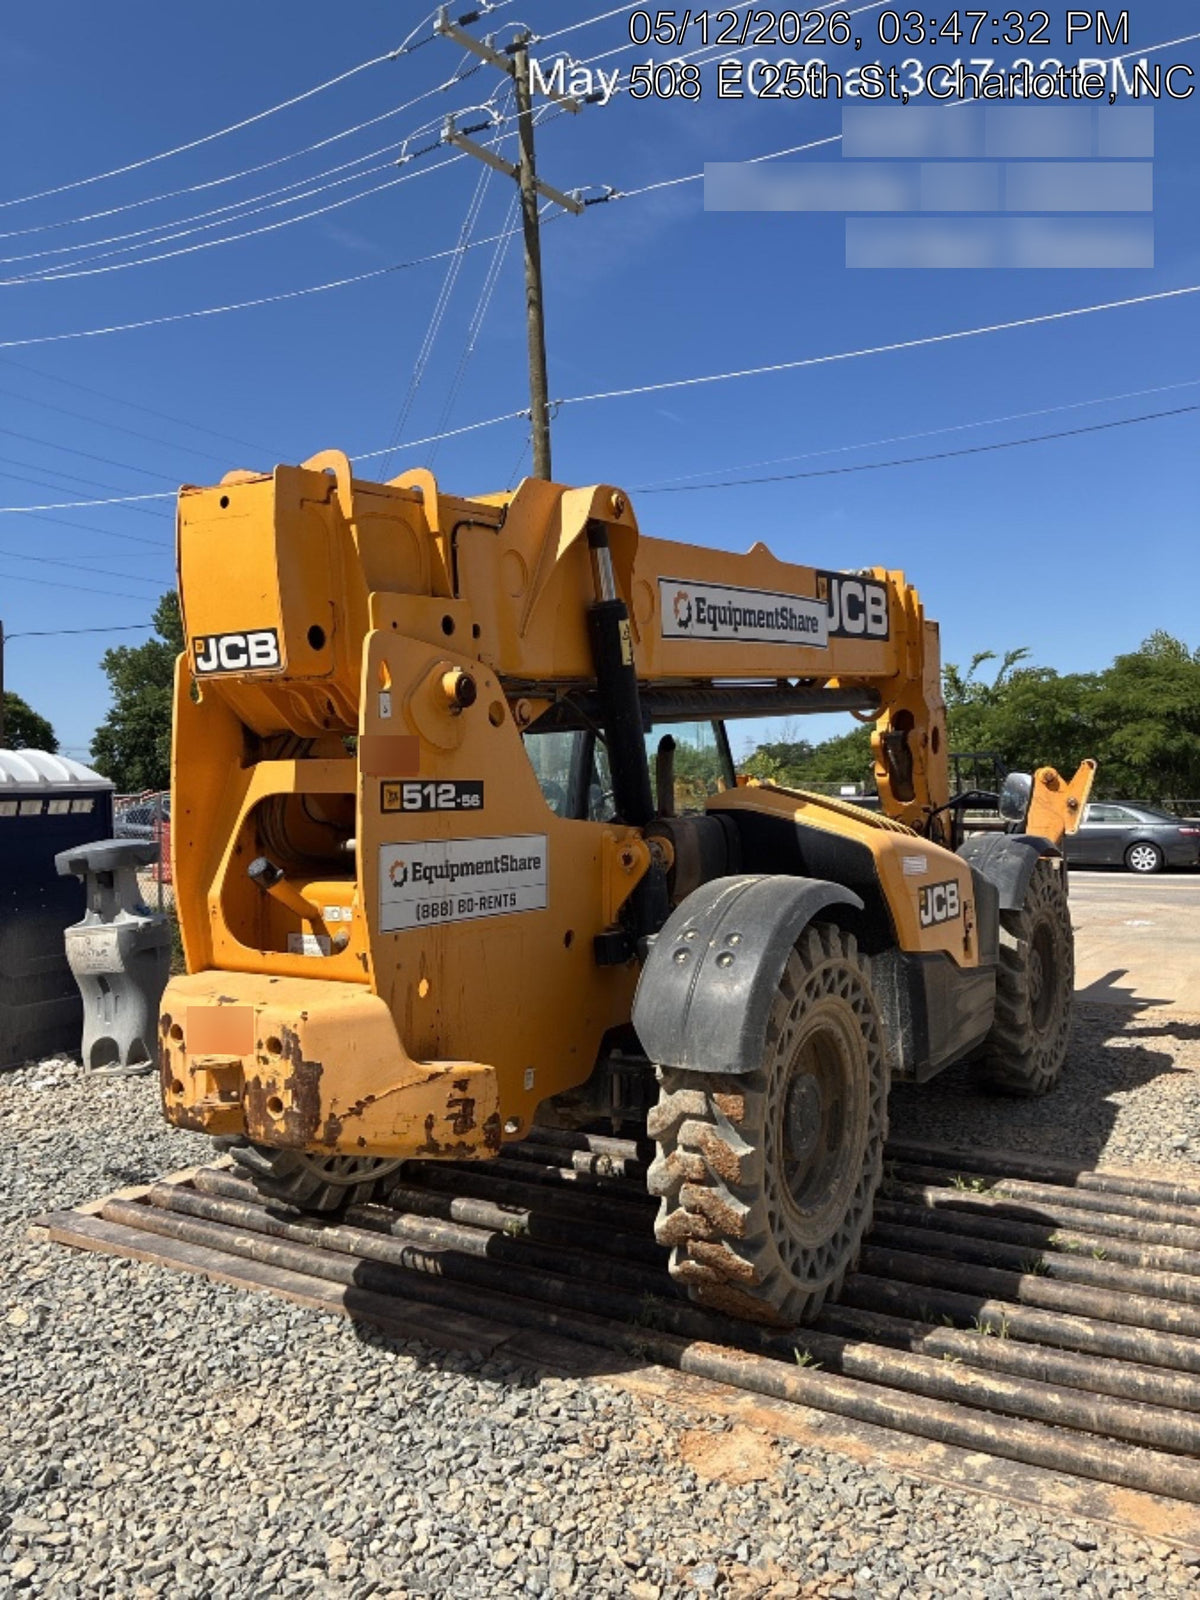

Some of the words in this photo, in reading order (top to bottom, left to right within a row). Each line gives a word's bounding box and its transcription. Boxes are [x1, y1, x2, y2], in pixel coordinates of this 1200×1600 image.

[694, 596, 819, 634] EquipmentShare
[827, 577, 889, 636] JCB
[196, 632, 279, 671] JCB
[411, 854, 541, 885] EquipmentShare
[415, 899, 453, 921] (888)
[920, 882, 960, 926] JCB
